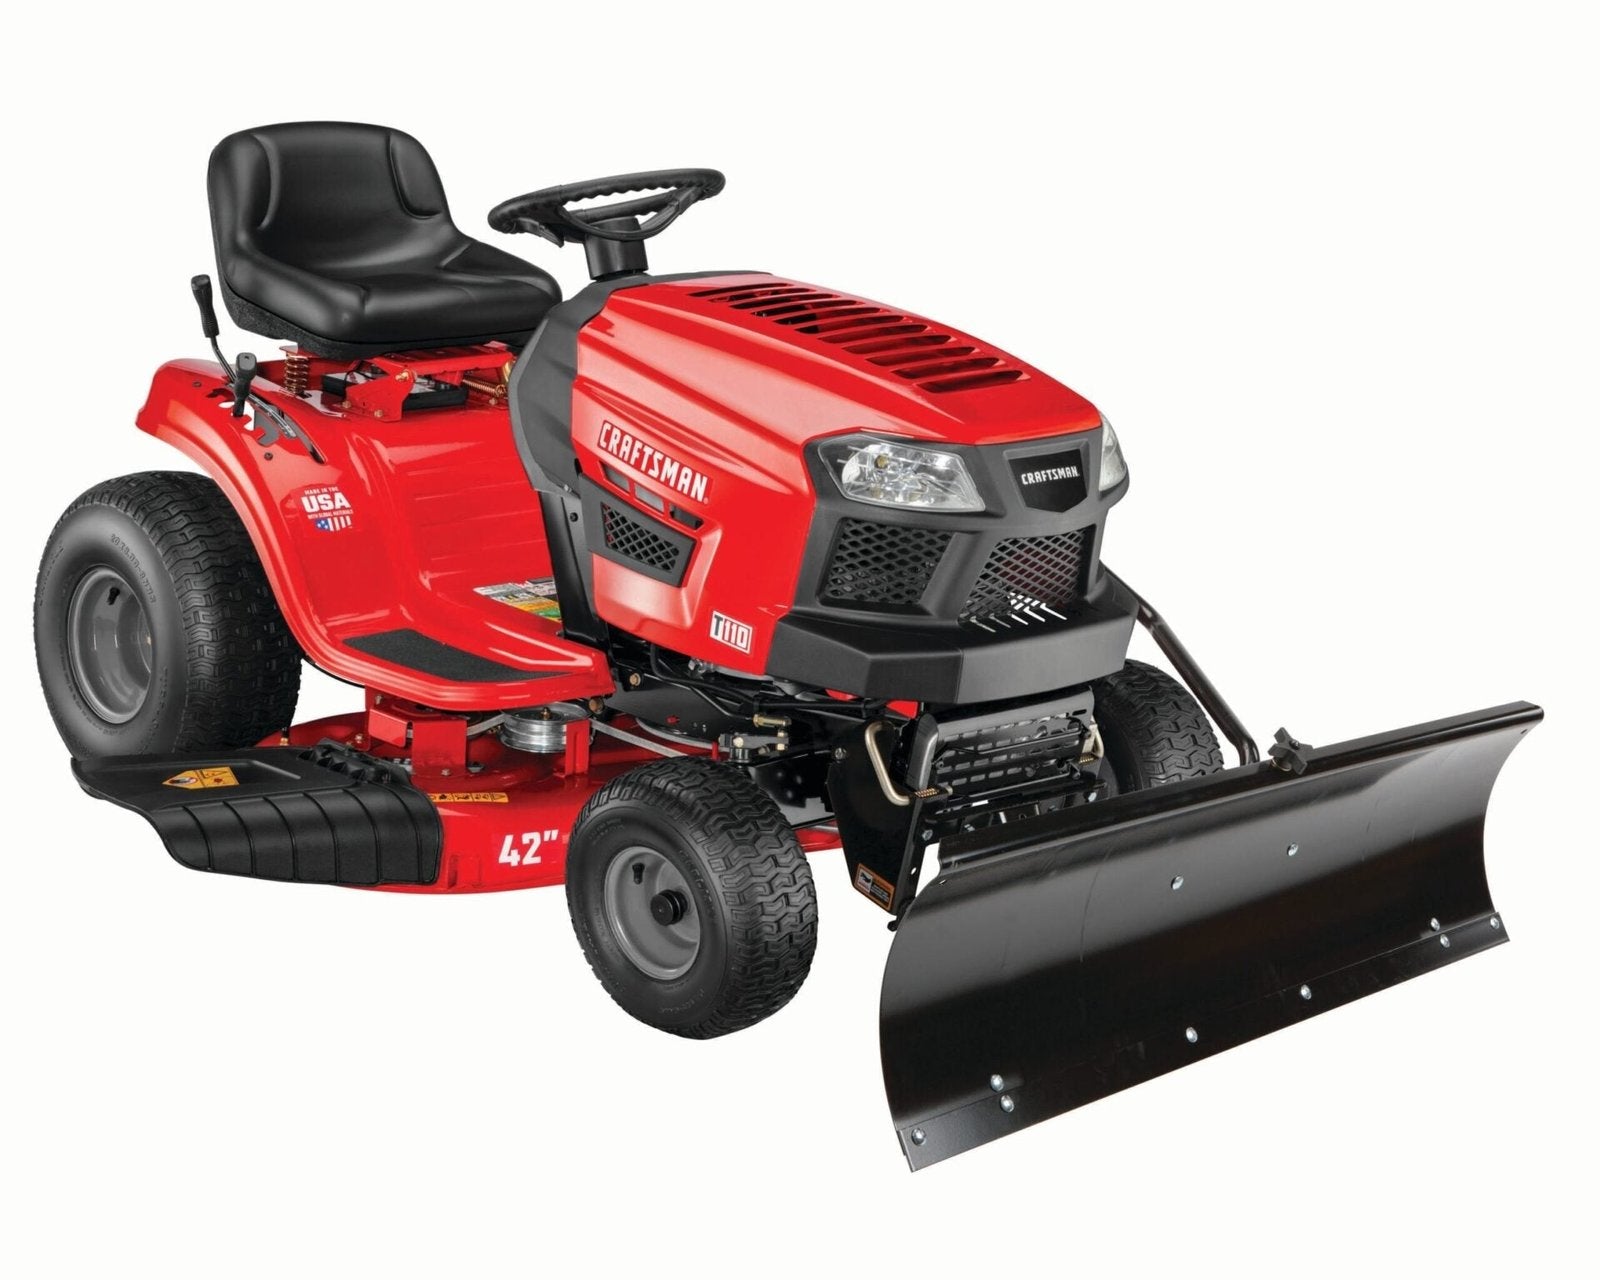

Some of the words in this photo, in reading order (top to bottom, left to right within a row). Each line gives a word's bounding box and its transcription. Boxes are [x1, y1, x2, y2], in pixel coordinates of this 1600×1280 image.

[600, 422, 707, 502] CRAFTSMAN
[1021, 466, 1078, 485] CRAFTSMAN
[301, 492, 351, 513] USA
[714, 614, 751, 649] T110
[499, 829, 559, 867] 42"
